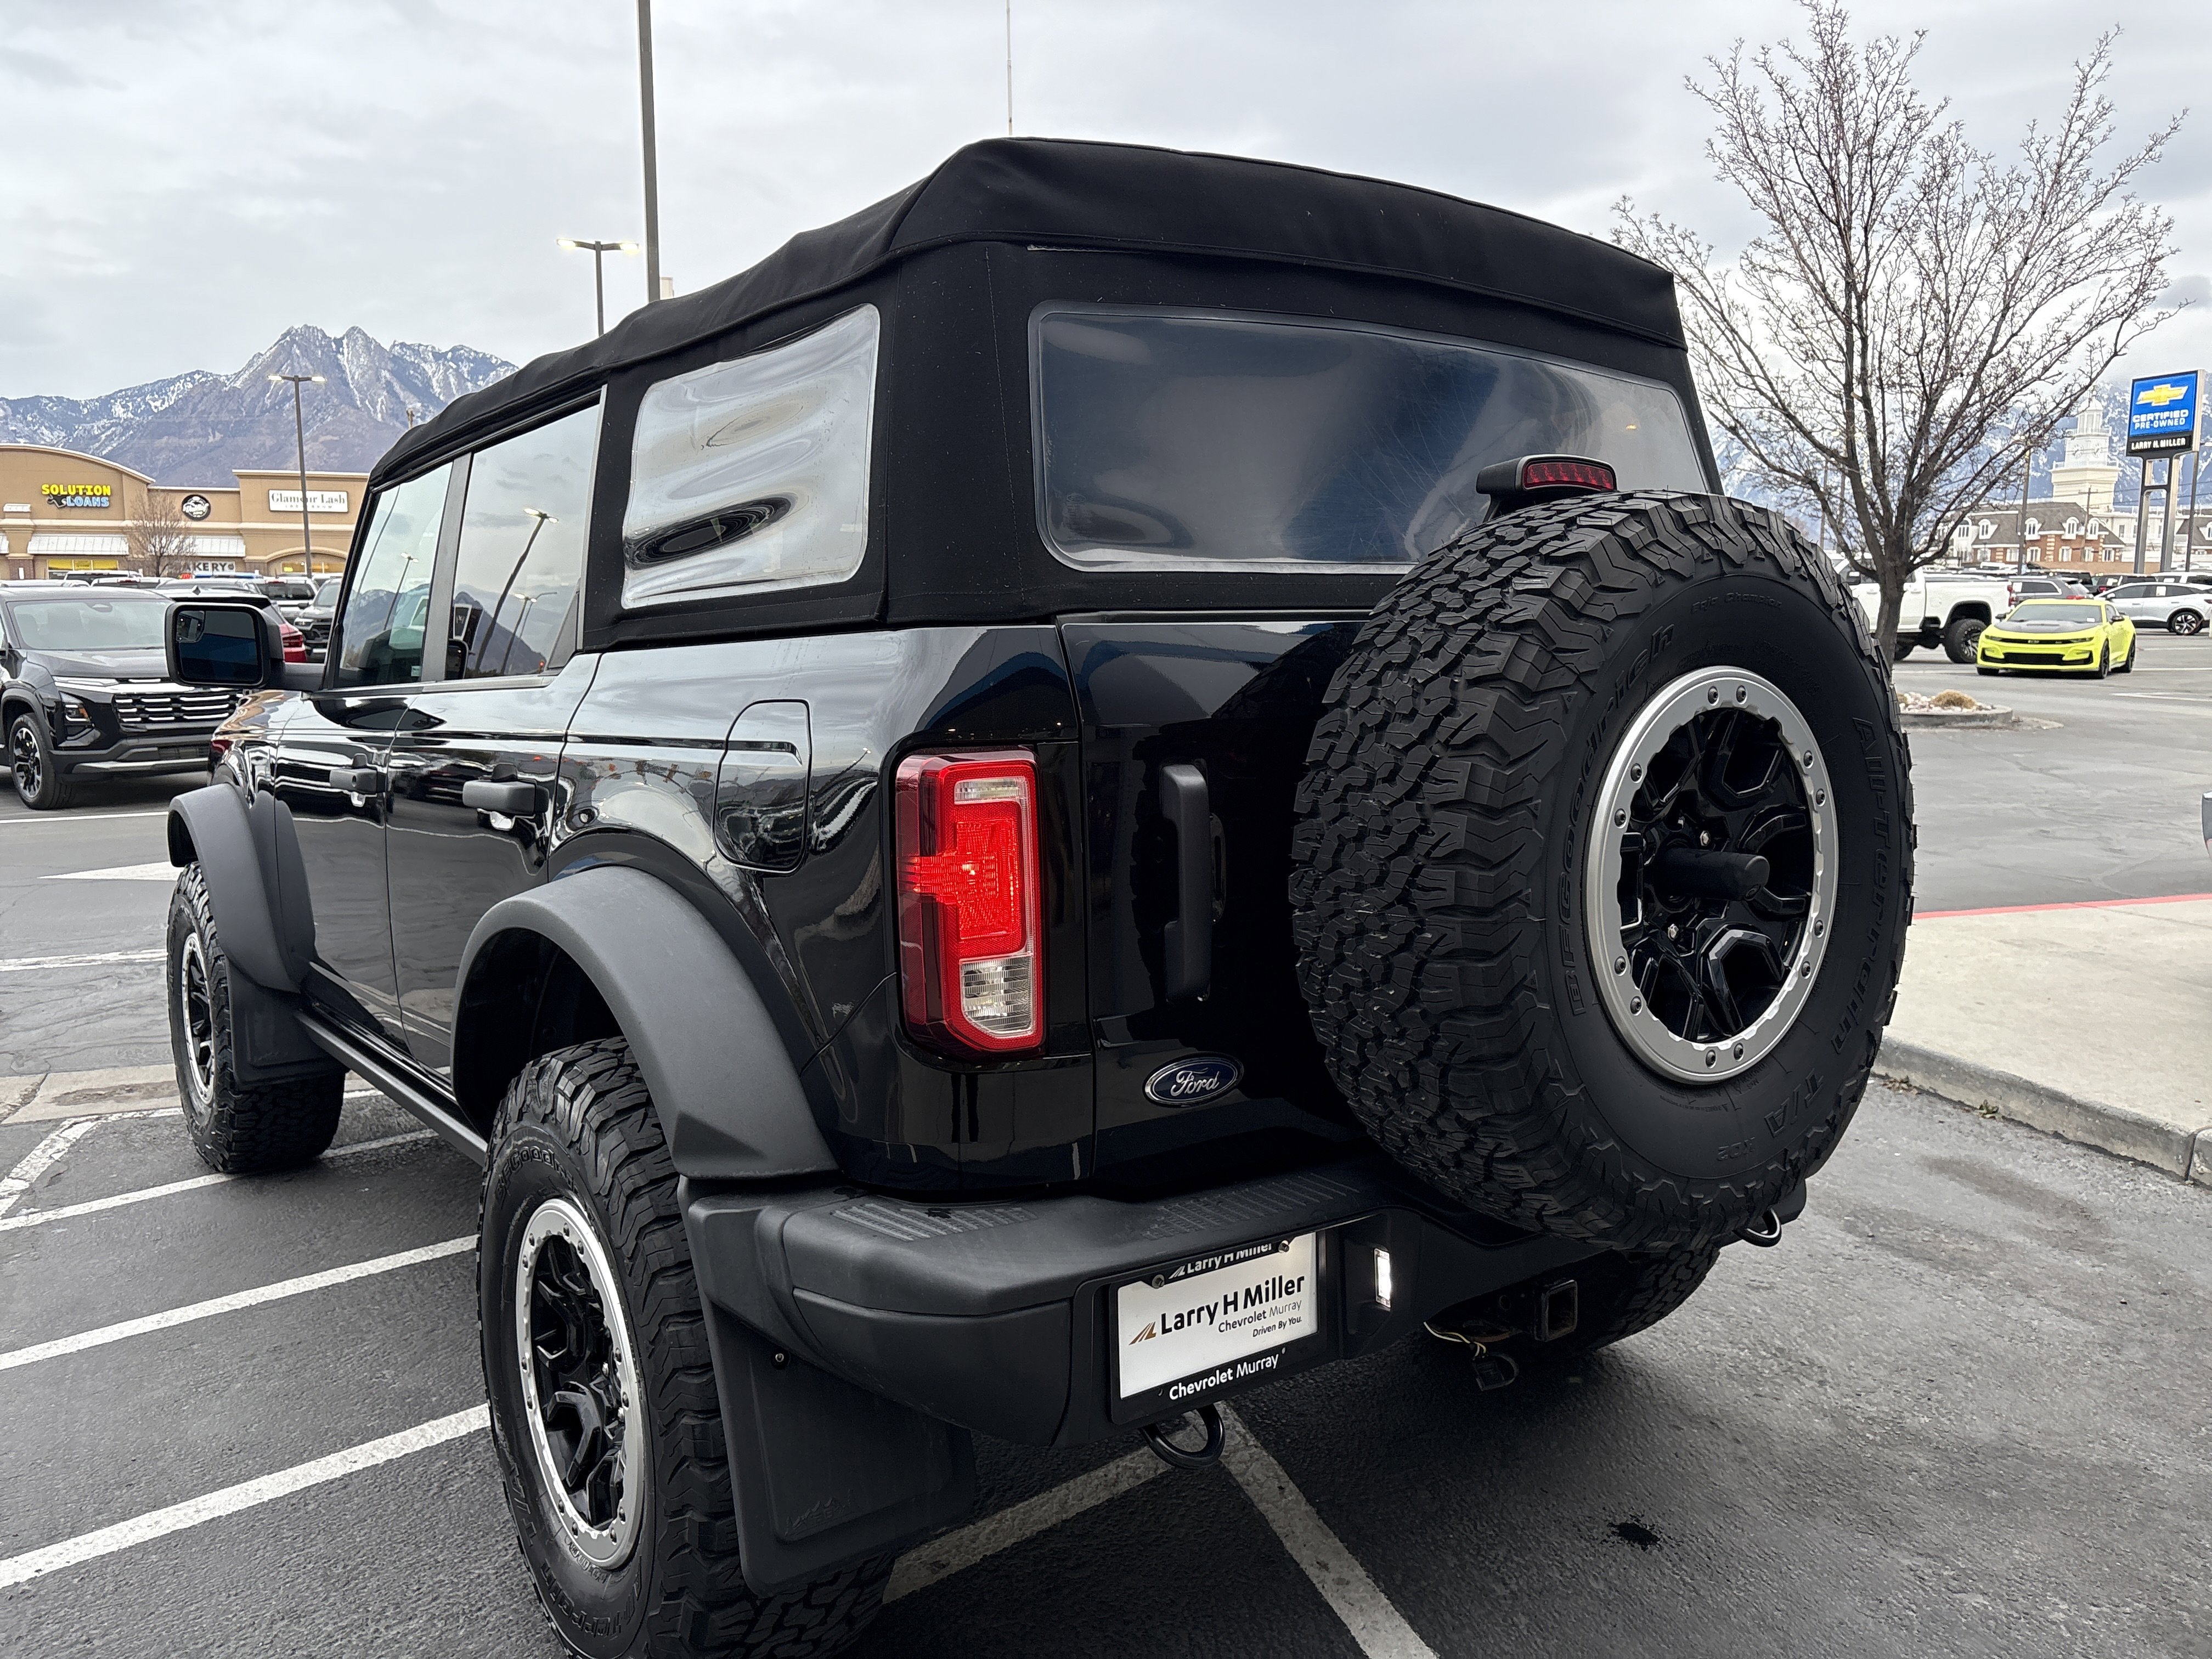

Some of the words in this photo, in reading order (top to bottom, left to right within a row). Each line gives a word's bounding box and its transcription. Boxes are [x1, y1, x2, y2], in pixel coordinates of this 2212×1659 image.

[2132, 409, 2189, 423] CERTIFIED
[2134, 417, 2186, 430] PRE-OWNED
[2131, 440, 2152, 450] LARRY
[2160, 437, 2186, 448] MILLER
[42, 484, 111, 496] SOLUTION
[66, 495, 110, 507] LOANS
[320, 493, 346, 504] Lash
[1170, 1067, 1221, 1097] Ford
[1187, 1255, 1222, 1274] Larry
[1223, 1252, 1234, 1263] H
[1160, 1301, 1219, 1335] Larry
[1223, 1290, 1238, 1316] H
[1243, 1274, 1305, 1310] Miller
[1218, 1310, 1267, 1333] Chevrolet
[1269, 1300, 1302, 1318] Murray
[1252, 1324, 1276, 1338] Driven
[1278, 1320, 1288, 1330] By
[1169, 1368, 1233, 1400] Chevrolet
[1235, 1353, 1279, 1379] Murray
